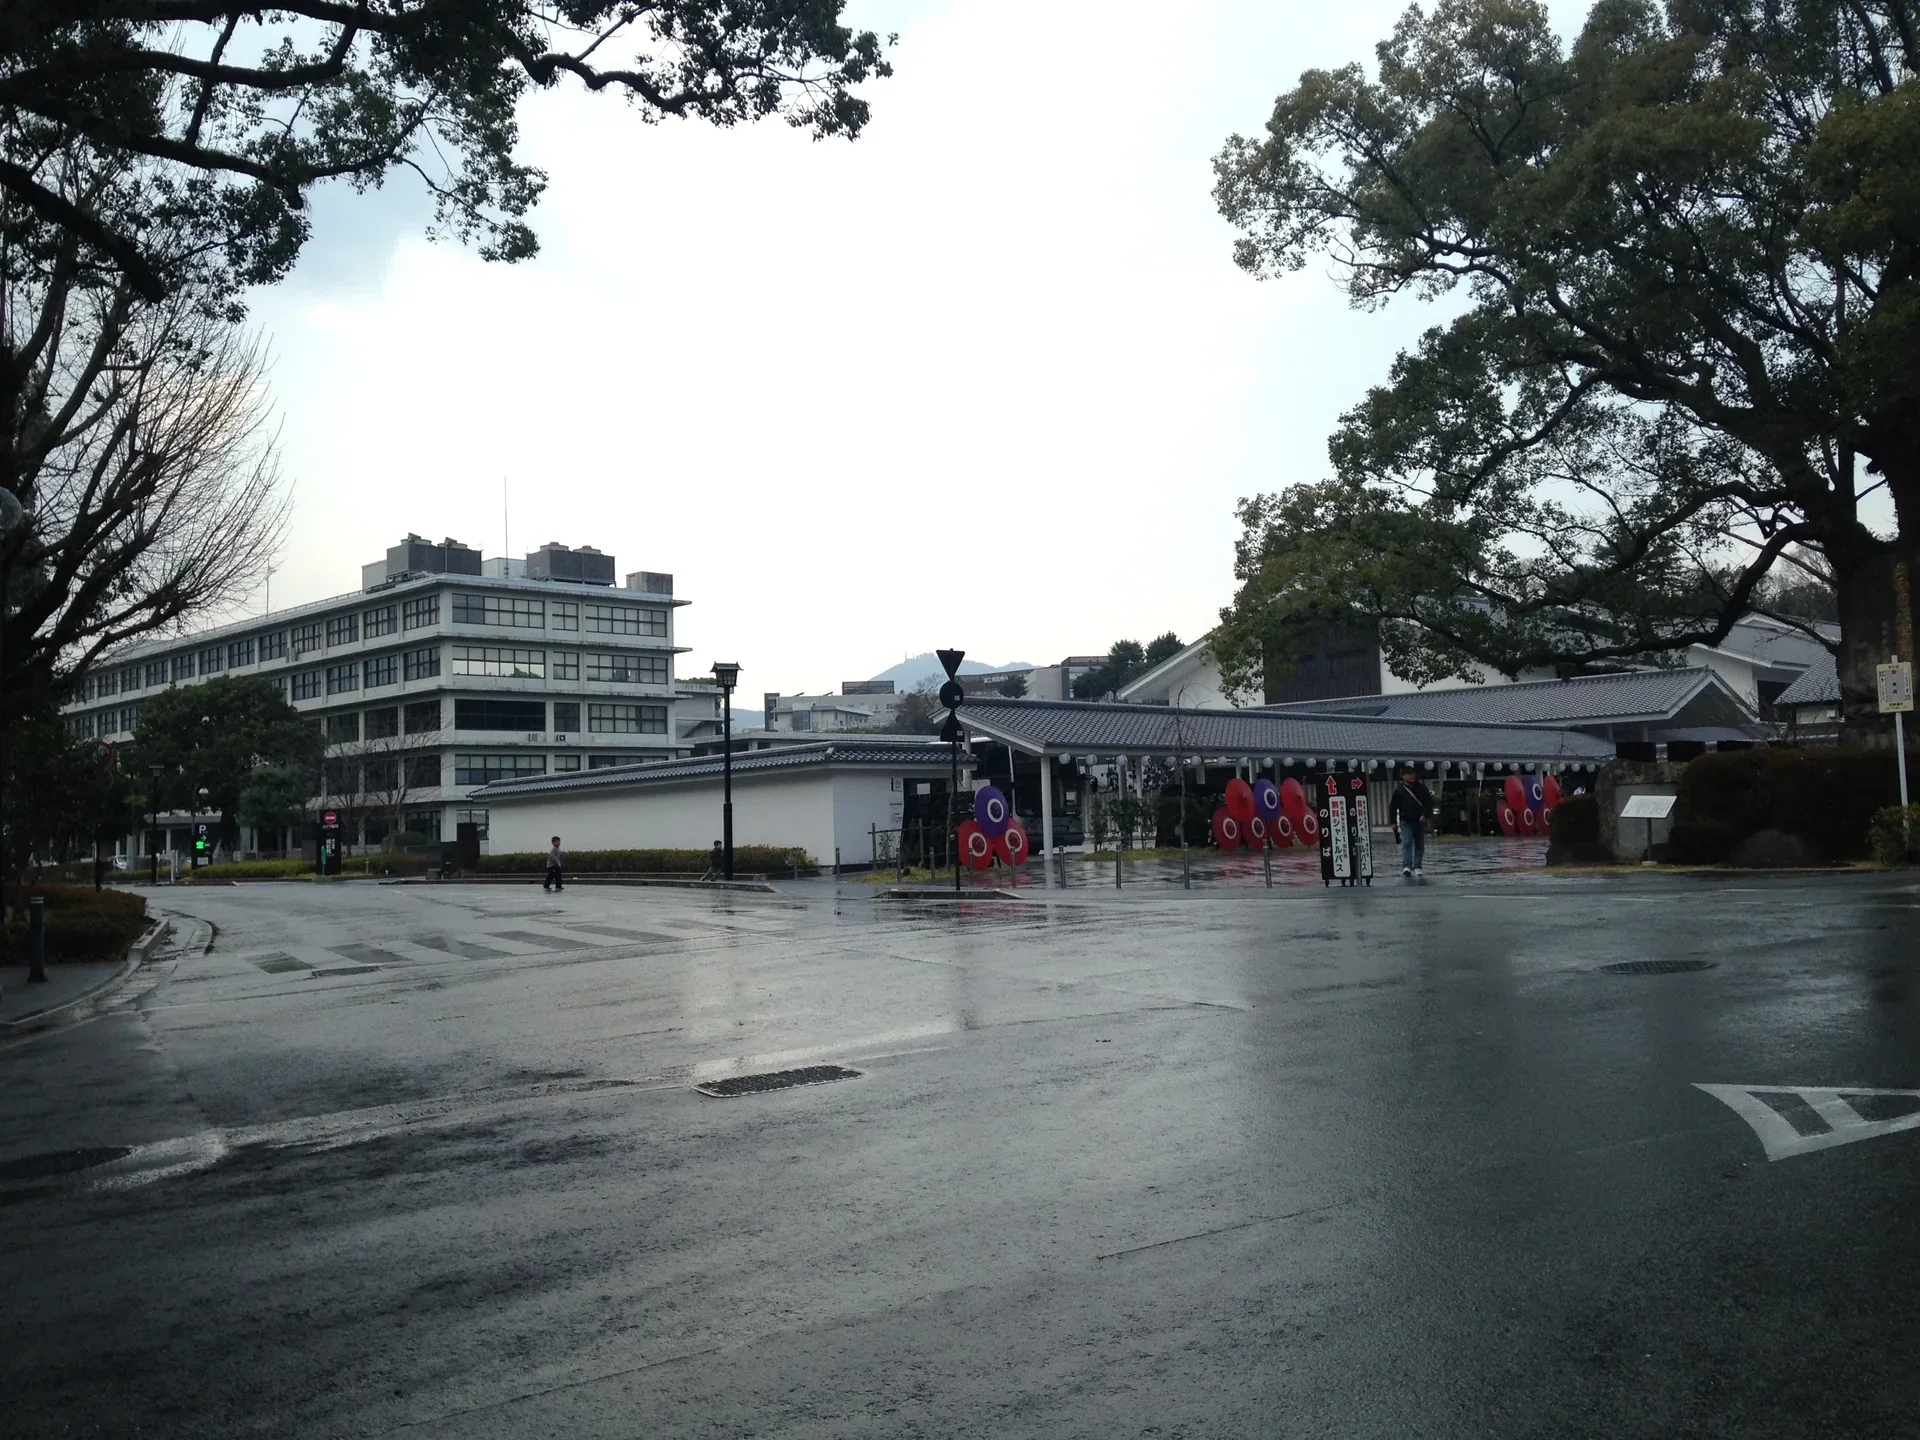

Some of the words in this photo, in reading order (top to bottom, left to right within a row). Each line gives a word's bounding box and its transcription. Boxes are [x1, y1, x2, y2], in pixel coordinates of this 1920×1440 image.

[199, 824, 207, 834] P
[1320, 809, 1331, 857] のりば
[1332, 801, 1343, 872] 無料シャトルバス
